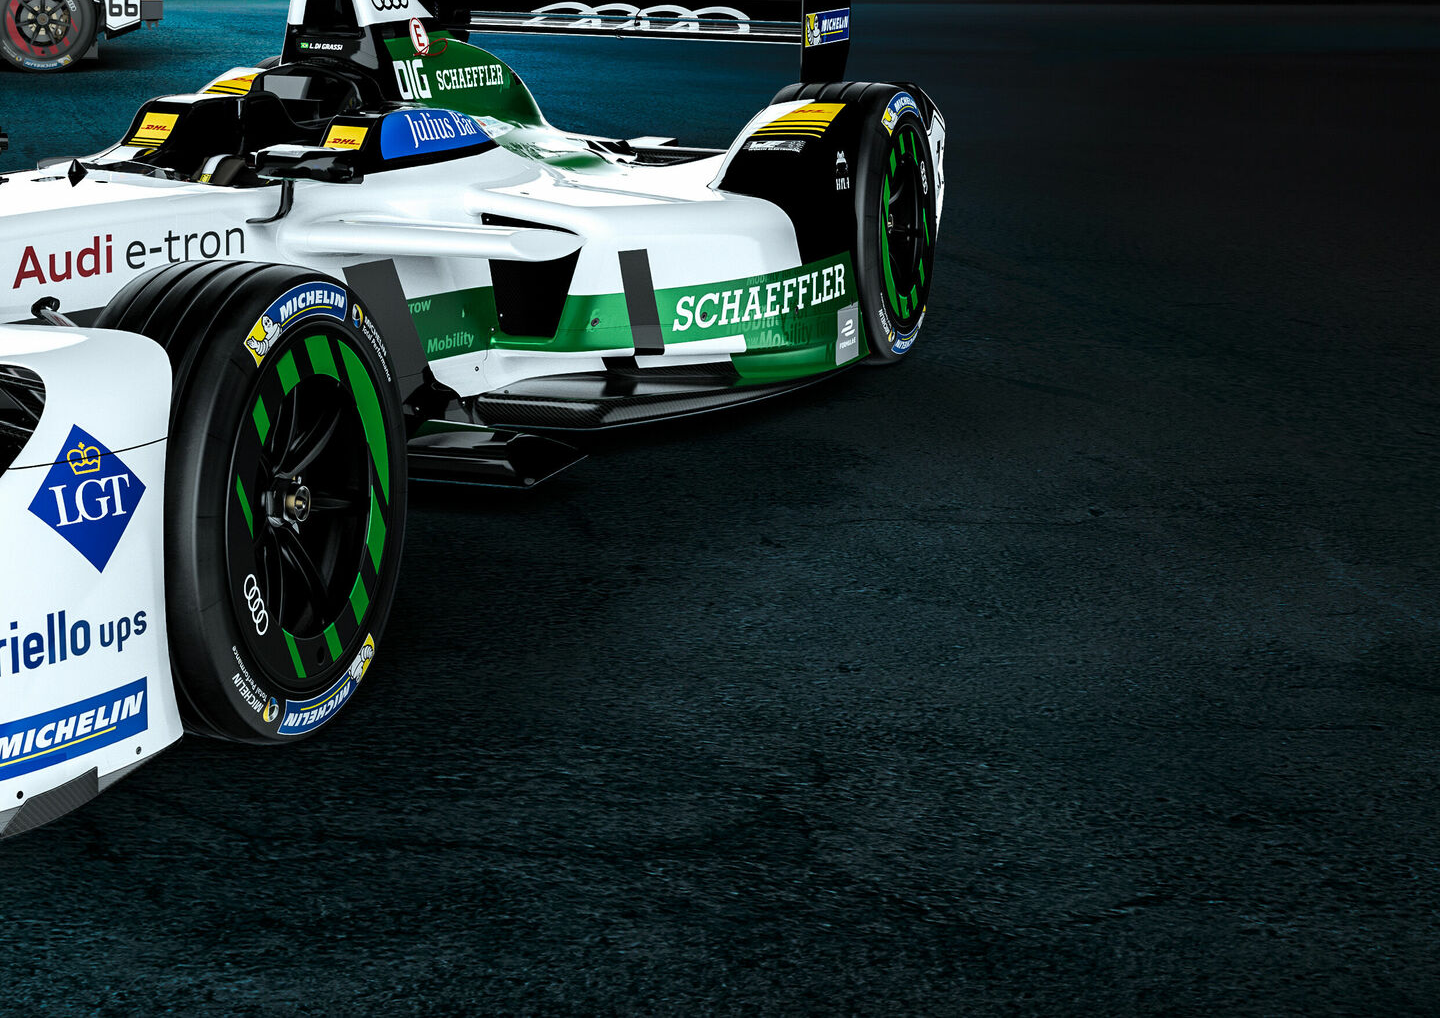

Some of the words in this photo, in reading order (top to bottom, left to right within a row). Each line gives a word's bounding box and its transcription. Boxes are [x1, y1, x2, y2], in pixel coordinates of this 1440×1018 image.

[820, 15, 849, 32] MICHELIN
[392, 59, 433, 100] DIG
[435, 64, 504, 91] SCHAEFFLER
[331, 137, 357, 146] DHL
[404, 113, 456, 149] Julius
[453, 110, 478, 137] Bär
[12, 234, 113, 289] Audi
[126, 226, 245, 270] e-tron
[279, 289, 345, 323] MICHELIN
[672, 263, 846, 332] SCHAEFFLER
[364, 315, 387, 357] MICHELIN
[426, 331, 475, 354] Mobility
[48, 473, 130, 527] LGT
[99, 610, 148, 653] ups
[232, 645, 257, 691] Performance
[231, 672, 264, 713] MICHELIN
[283, 680, 352, 728] MICHELIN
